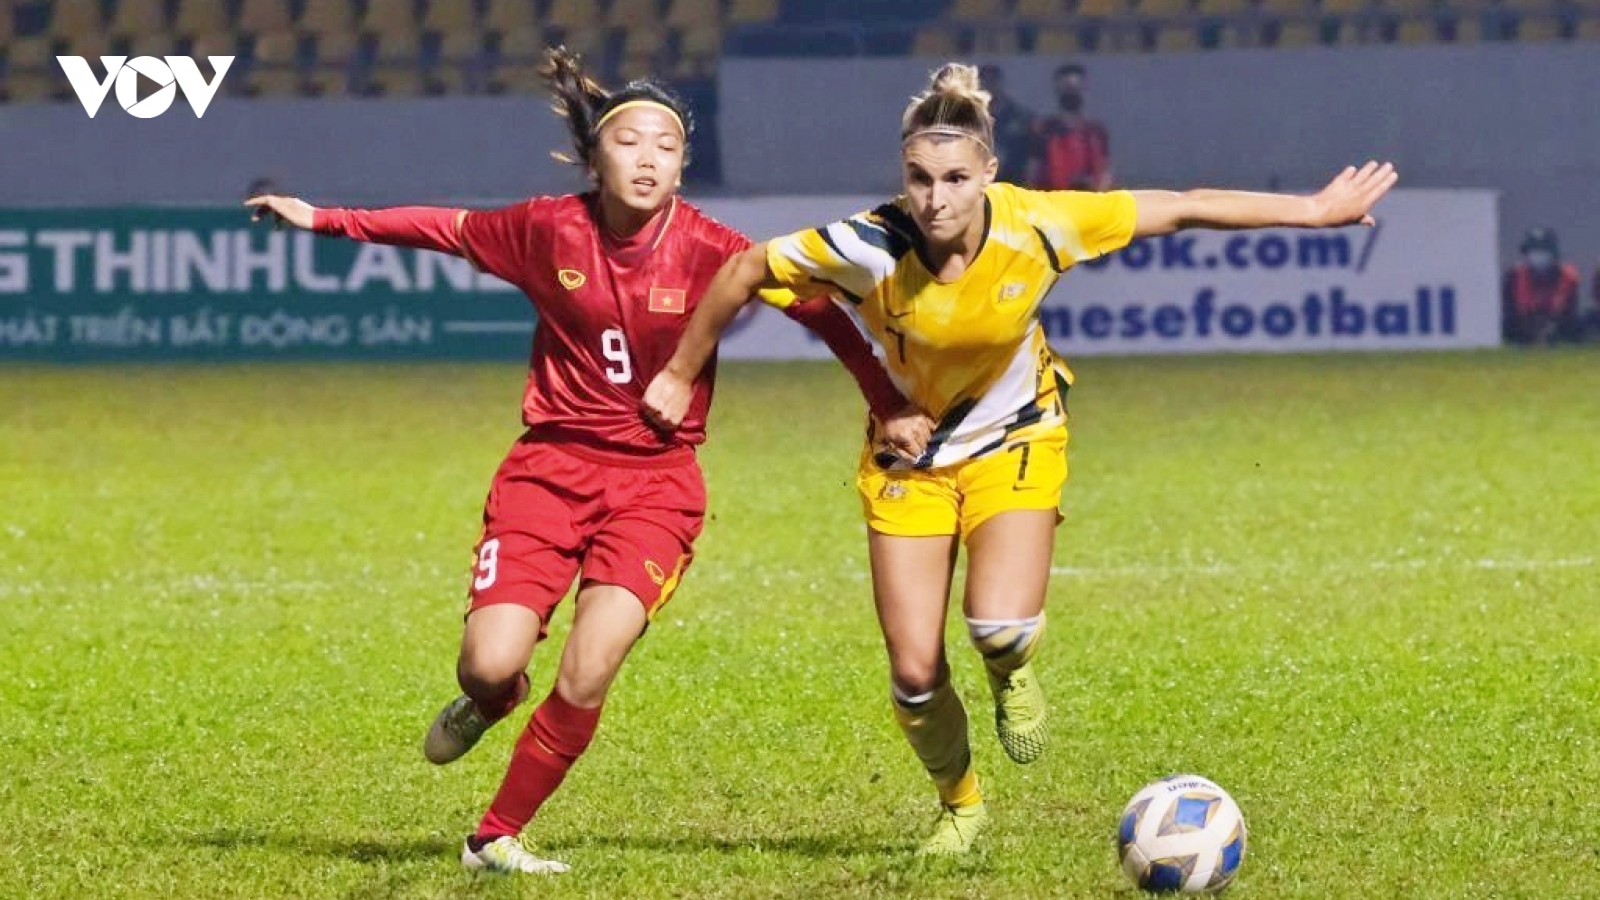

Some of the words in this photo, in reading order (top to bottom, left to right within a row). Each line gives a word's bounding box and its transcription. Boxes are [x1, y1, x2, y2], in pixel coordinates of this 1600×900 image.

[1083, 217, 1383, 274] ok.com/
[601, 328, 633, 384] 9
[885, 326, 906, 365] 7
[1008, 441, 1031, 481] 7
[474, 538, 500, 591] 9
